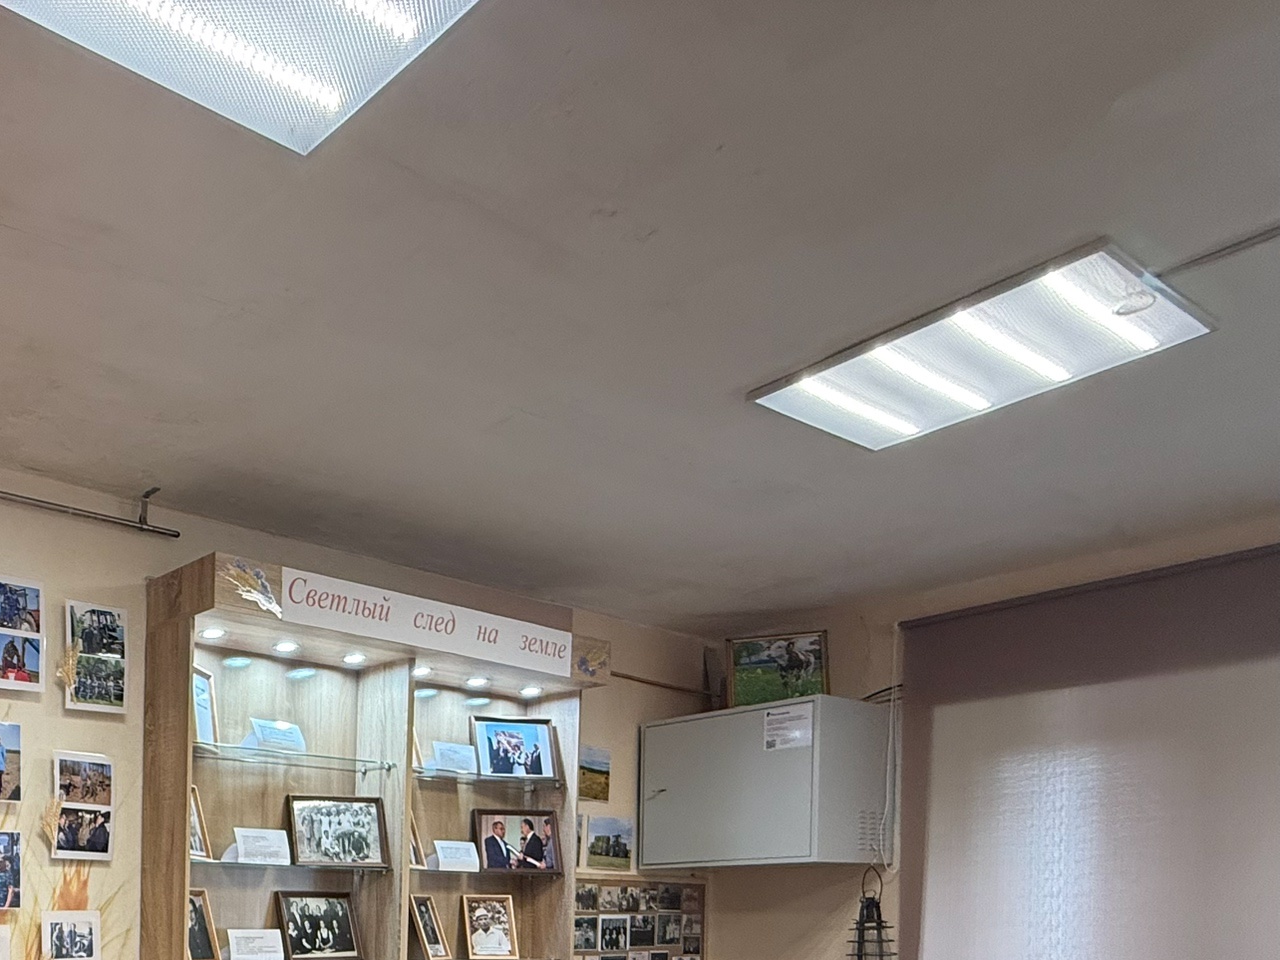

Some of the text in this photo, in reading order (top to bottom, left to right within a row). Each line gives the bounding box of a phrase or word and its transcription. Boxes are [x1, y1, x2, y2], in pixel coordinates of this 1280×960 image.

[287, 577, 568, 660] Светлый след на земле
